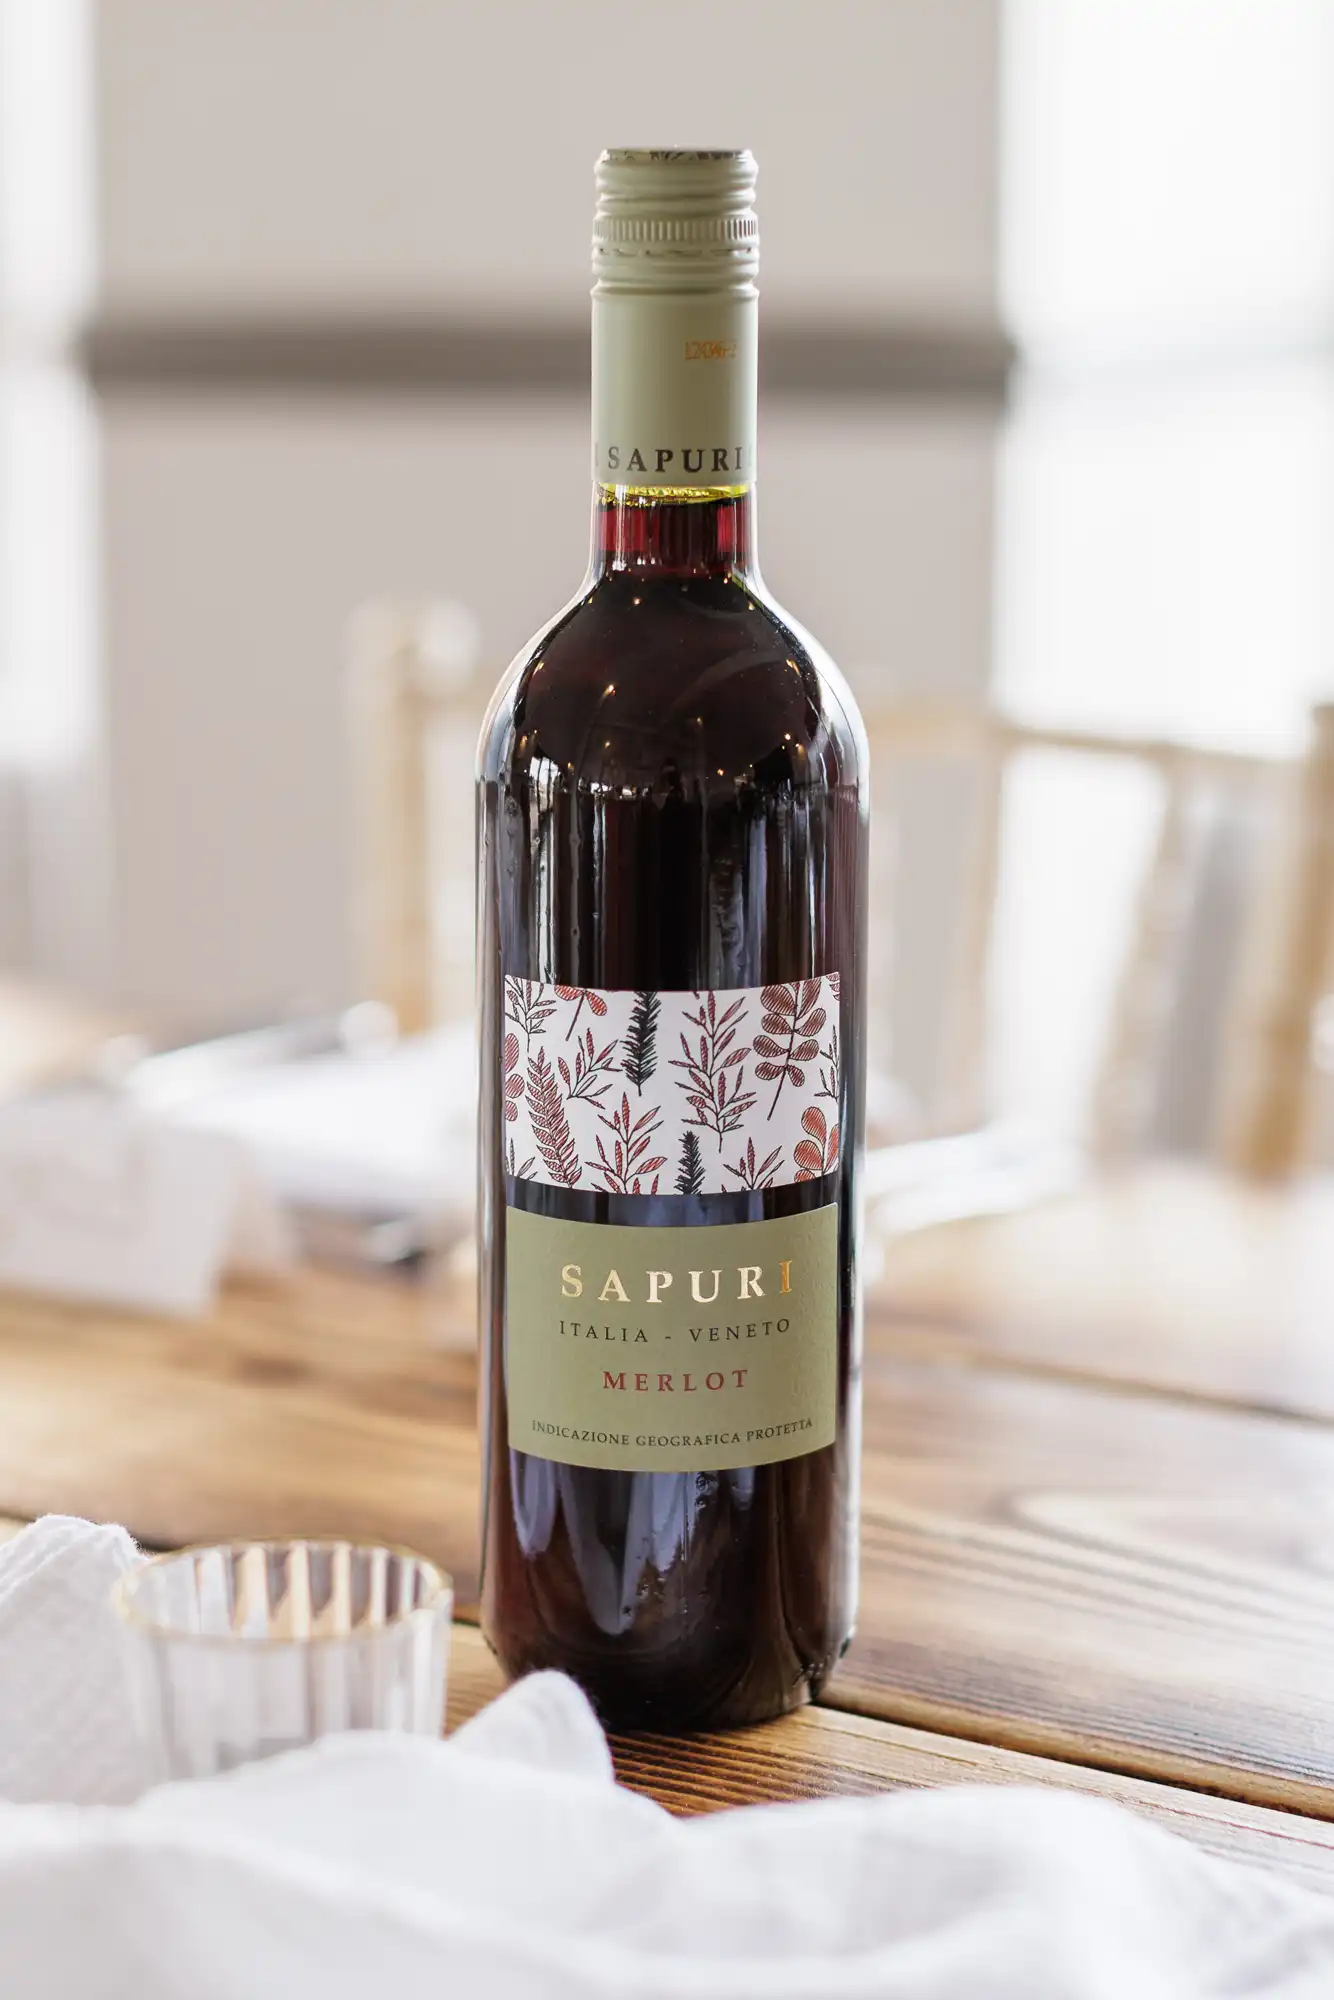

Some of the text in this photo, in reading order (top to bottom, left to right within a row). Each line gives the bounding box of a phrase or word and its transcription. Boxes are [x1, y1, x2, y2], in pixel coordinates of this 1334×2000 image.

[608, 446, 743, 473] SAPURI
[561, 1259, 793, 1303] SAPURI
[559, 1320, 648, 1343] ITALIA
[689, 1318, 790, 1342] VENETO
[602, 1369, 748, 1392] MERLOT
[532, 1417, 813, 1446] INDICAZIONE GEOGRAFICA PROTETTA
